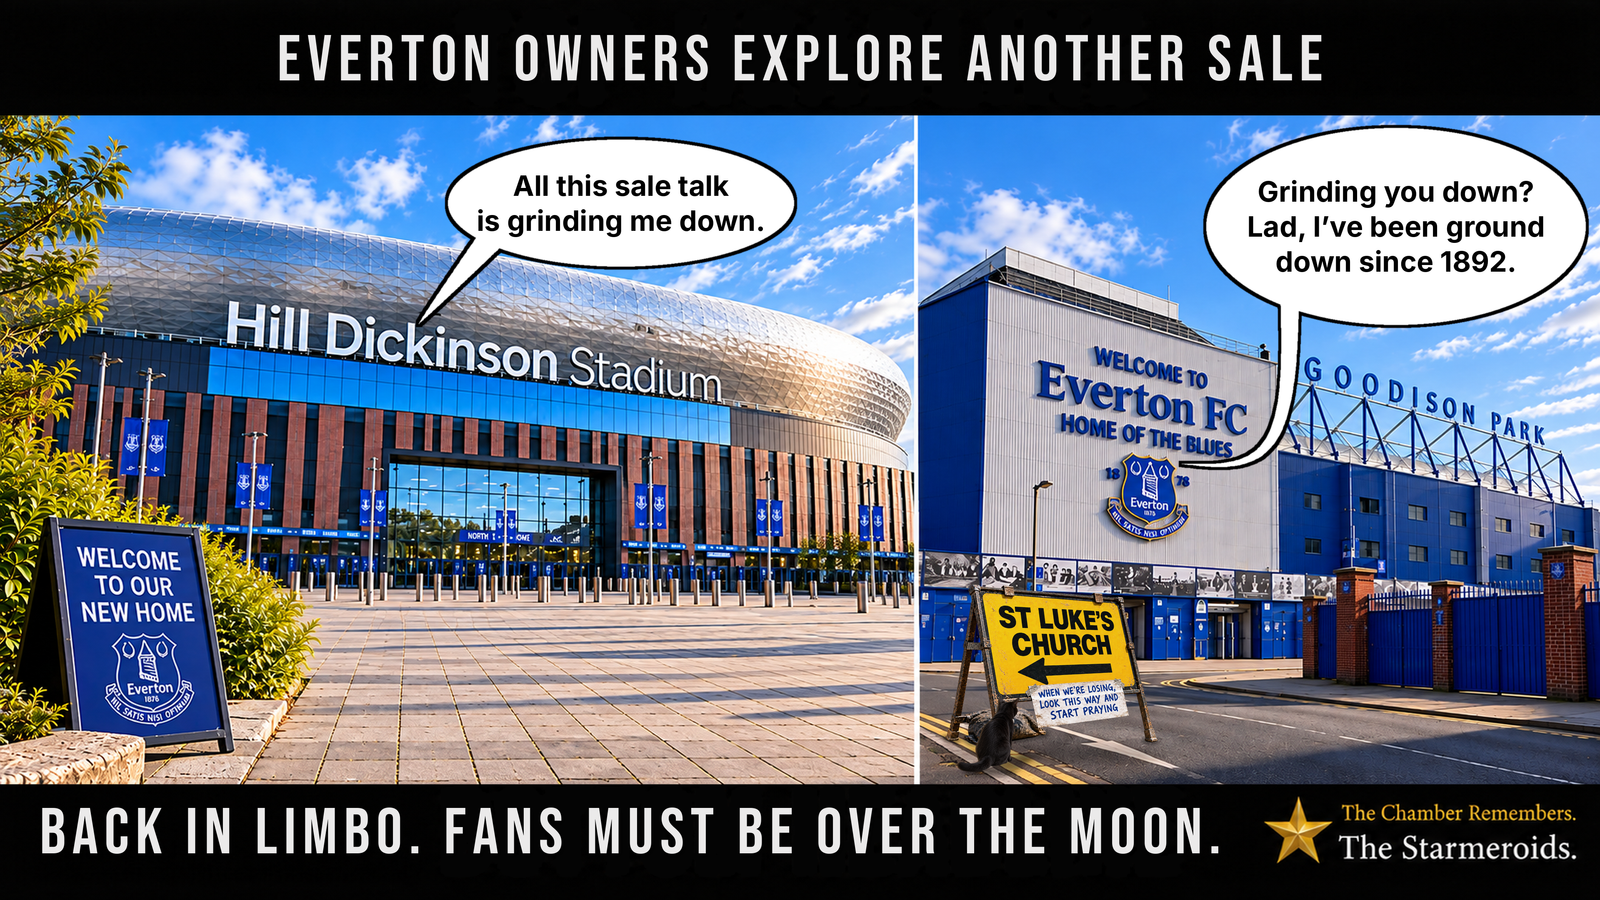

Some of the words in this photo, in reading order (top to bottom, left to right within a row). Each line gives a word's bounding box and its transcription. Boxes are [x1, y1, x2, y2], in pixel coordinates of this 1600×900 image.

[226, 300, 310, 352] Hill
[326, 313, 559, 381] Dickinson
[568, 346, 723, 403] Stadium
[1094, 346, 1183, 384] WELCOME
[1187, 369, 1208, 389] TO
[1036, 360, 1196, 426] Everton
[1205, 396, 1247, 435] FC
[1304, 356, 1475, 425] GOODISON
[1491, 411, 1545, 445] PARK
[1061, 413, 1117, 440] HOME
[1122, 424, 1145, 444] OF
[1149, 428, 1182, 450] THE
[1186, 435, 1233, 458] BLUES
[1105, 467, 1121, 480] 18
[1175, 475, 1190, 487] 78
[1130, 497, 1169, 511] Everton
[76, 546, 182, 571] WELCOME
[94, 575, 124, 595] TO
[130, 576, 174, 596] OUR
[81, 601, 129, 623] NEW
[135, 602, 196, 623] HOME
[998, 605, 1032, 629] ST
[1038, 607, 1115, 632] LUKE’S
[1012, 632, 1113, 657] CHURCH
[127, 683, 174, 696] Everton
[1038, 688, 1060, 698] WHEN
[1062, 685, 1085, 696] WE'RE
[1087, 683, 1117, 694] LOSING,
[1039, 699, 1060, 709] LOOK
[1062, 696, 1081, 706] THIS
[1084, 694, 1101, 704] WAY
[1104, 693, 1119, 702] AND
[1050, 707, 1079, 720] START
[1082, 703, 1119, 716] PRAYING
[122, 707, 145, 721] SATIS
